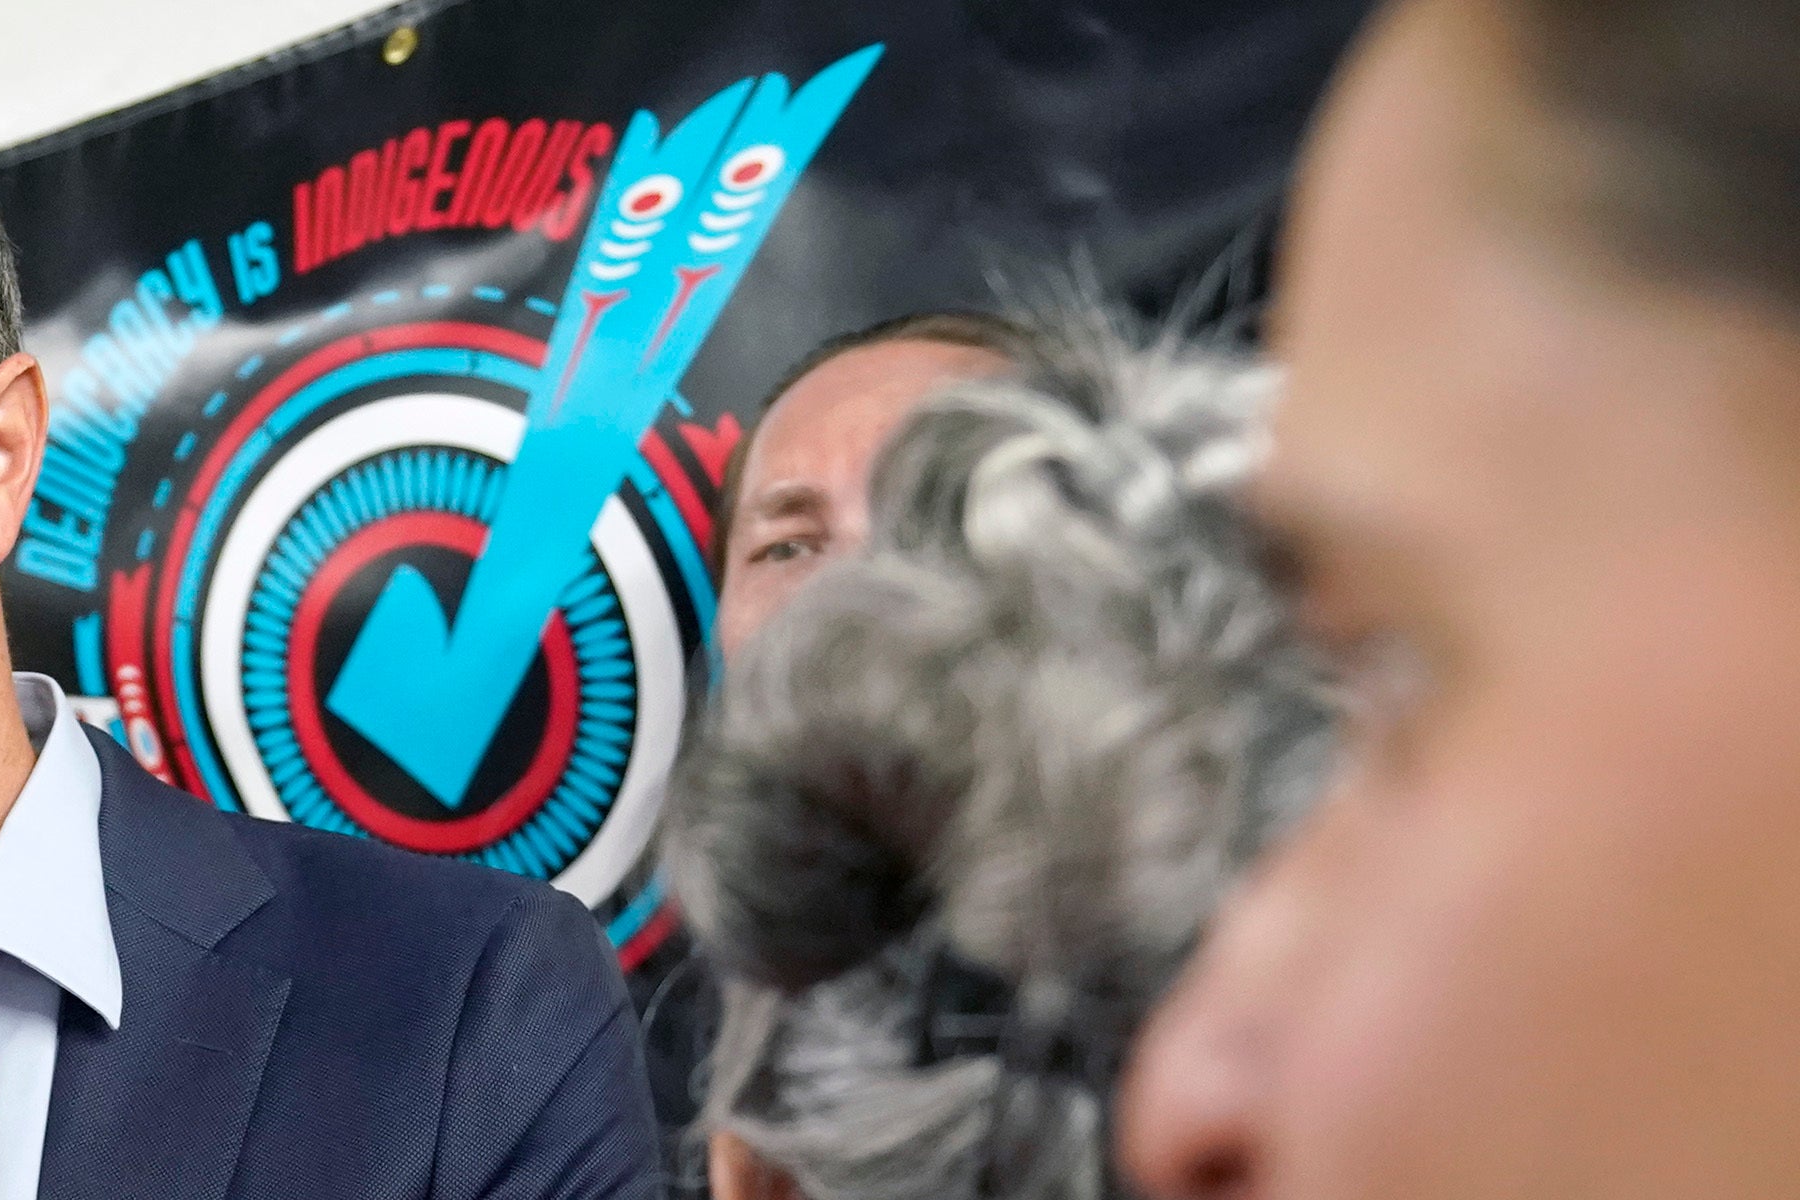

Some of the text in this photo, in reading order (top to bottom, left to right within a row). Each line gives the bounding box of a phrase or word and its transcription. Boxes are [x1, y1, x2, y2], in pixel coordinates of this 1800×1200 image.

[14, 115, 614, 592] DEMOCRACY IS INDIGENOUS
